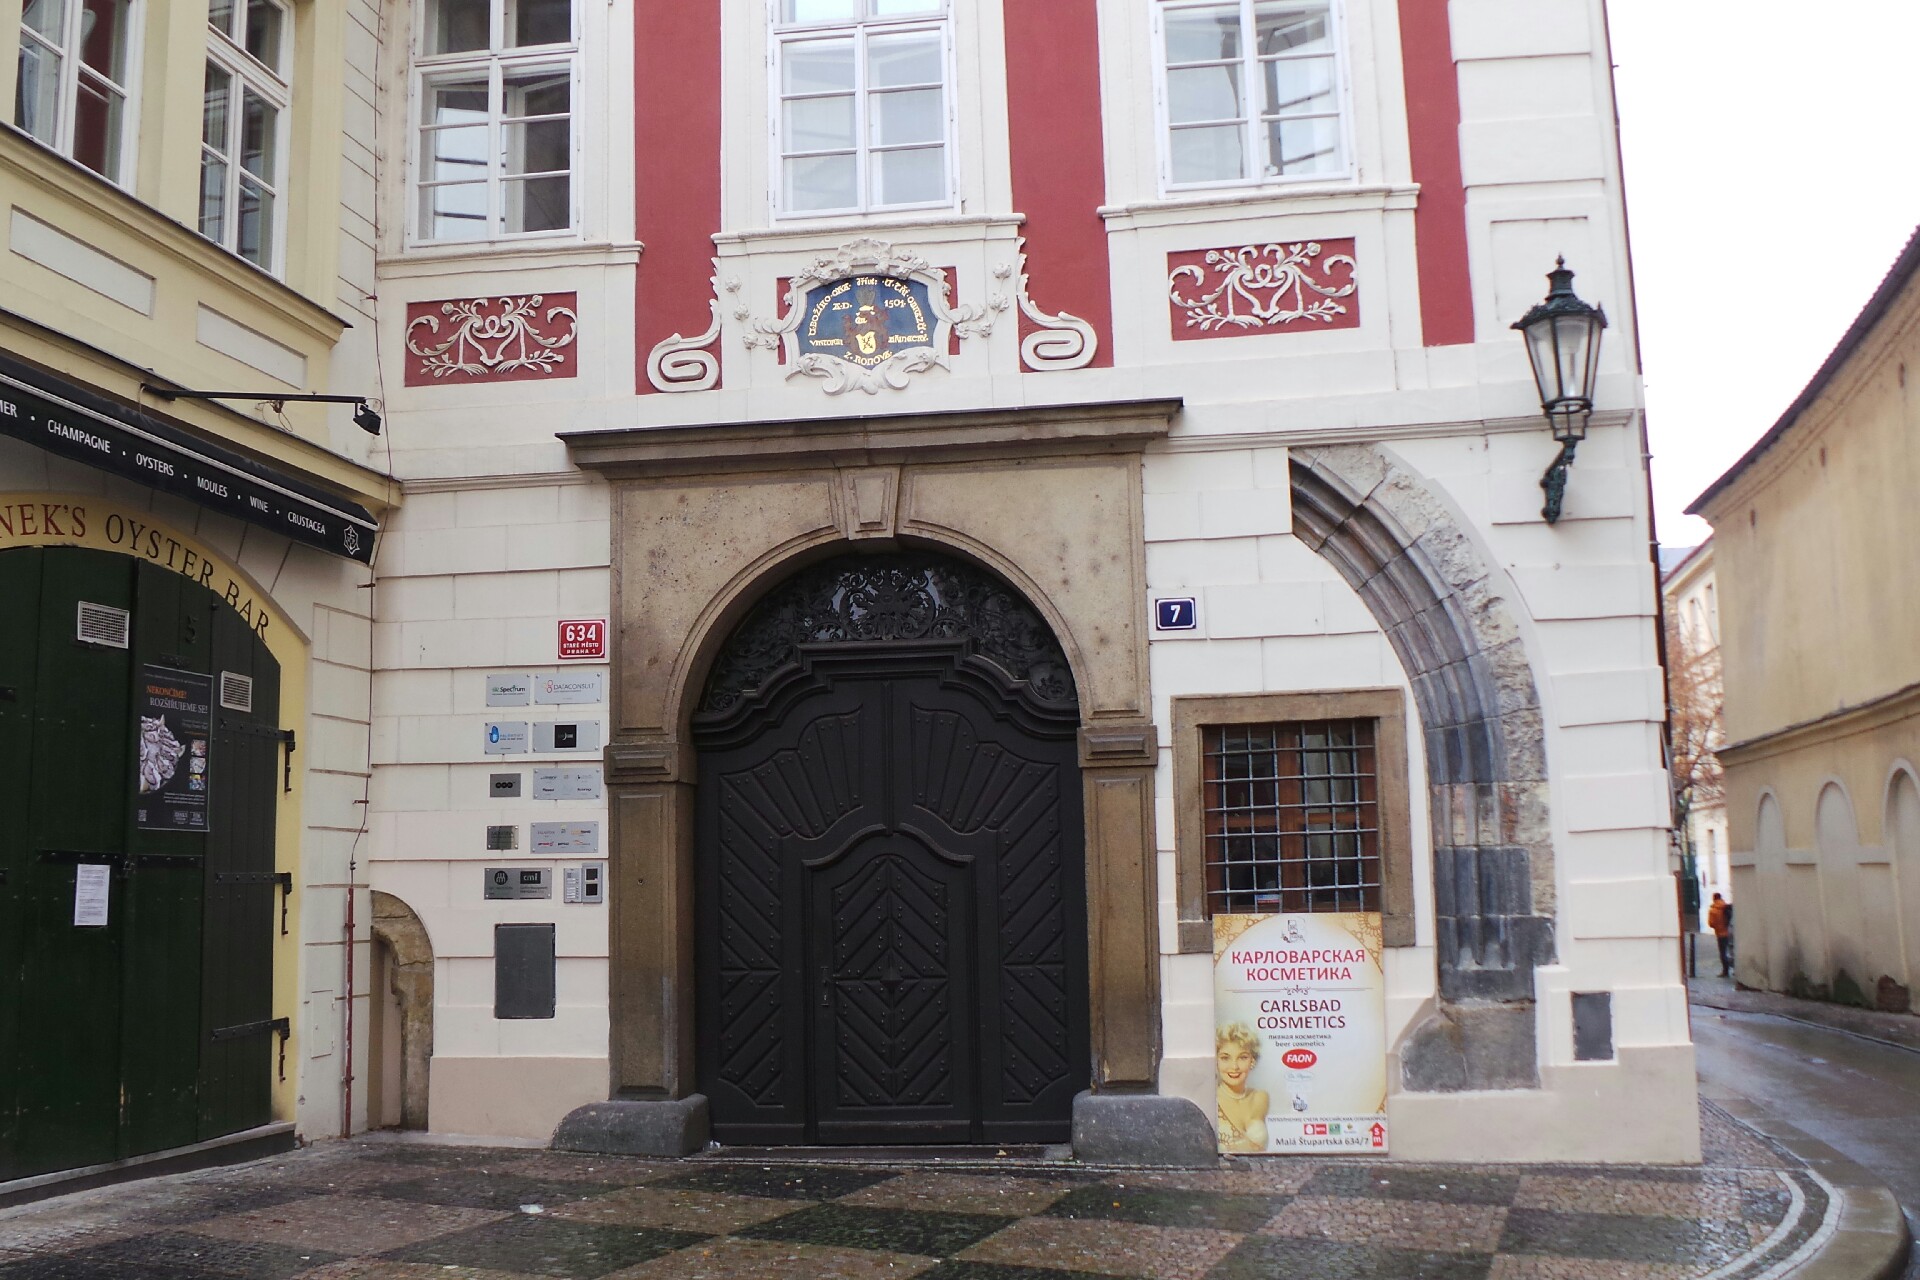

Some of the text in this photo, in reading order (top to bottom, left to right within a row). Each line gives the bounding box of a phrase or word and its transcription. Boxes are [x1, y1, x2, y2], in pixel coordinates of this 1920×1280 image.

[47, 419, 111, 454] CHAMPAGNE
[136, 452, 174, 477] OYSTERS
[197, 475, 228, 498] MOULES
[249, 495, 269, 513] WINE
[287, 511, 326, 535] CRUSTACEA
[105, 513, 214, 590] OYSTER
[224, 578, 269, 643] BAR
[1170, 604, 1181, 623] 7
[566, 624, 596, 641] 634
[1231, 949, 1365, 964] КАРЛОВАРСКАЯ
[1247, 967, 1352, 981] КОСМЕТИКА
[1260, 999, 1341, 1013] CARLSBAD
[1257, 1015, 1346, 1029] COSMETICS
[1286, 1054, 1313, 1063] FAON
[1275, 1137, 1297, 1146] Malá
[1344, 1137, 1369, 1146] 634/7
